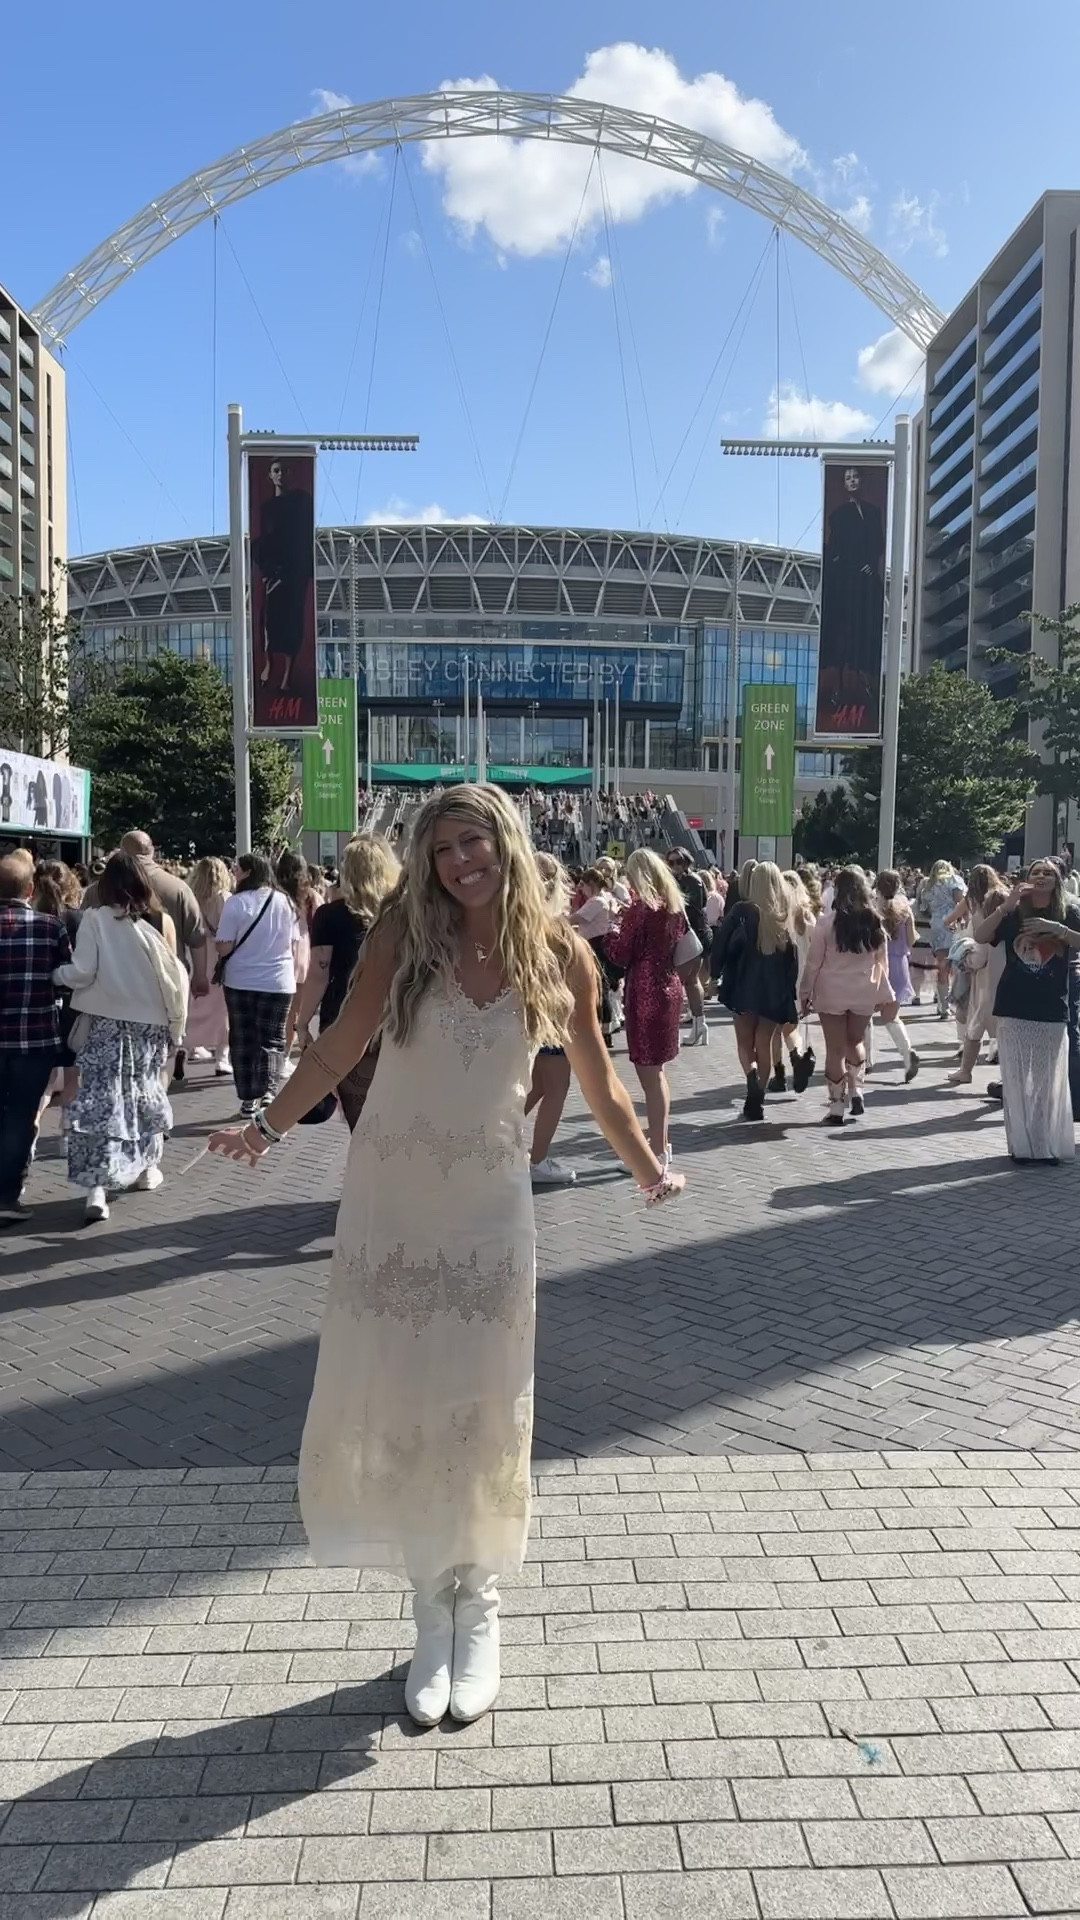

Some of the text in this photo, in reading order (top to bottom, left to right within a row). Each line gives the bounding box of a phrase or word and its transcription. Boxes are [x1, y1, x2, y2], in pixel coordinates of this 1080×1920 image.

[444, 659, 594, 684] CONNECTED
[599, 663, 629, 685] BY
[635, 663, 664, 686] EE
[317, 696, 348, 708] REEN
[751, 702, 790, 714] GREEN
[318, 714, 344, 725] ONE
[754, 719, 785, 731] ZONE
[757, 776, 780, 786] Up the
